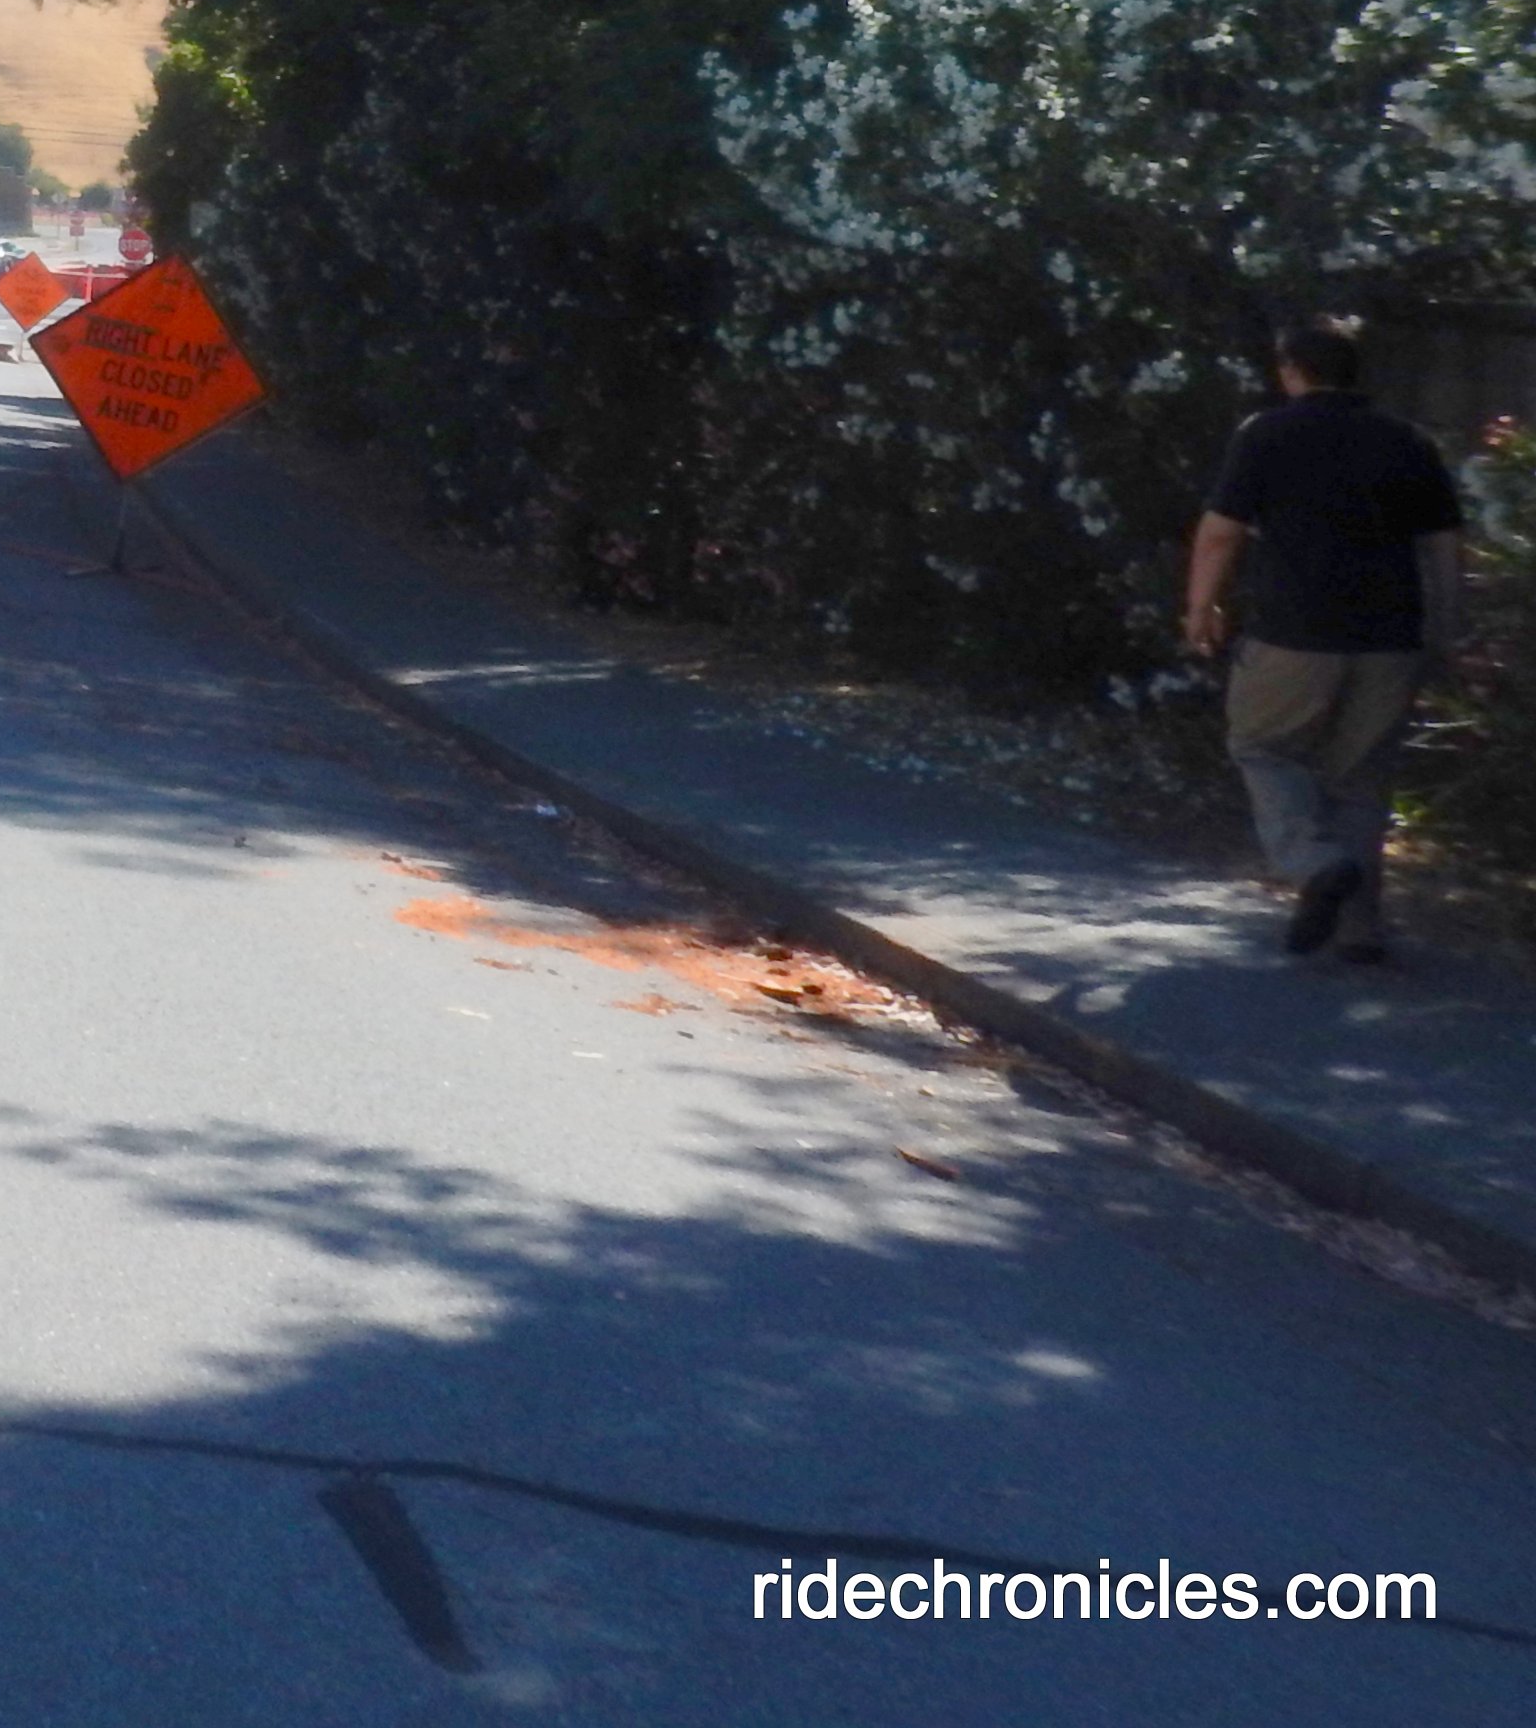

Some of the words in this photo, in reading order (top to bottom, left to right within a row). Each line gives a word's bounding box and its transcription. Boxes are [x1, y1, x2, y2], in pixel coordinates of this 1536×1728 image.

[119, 240, 150, 253] STOP
[87, 320, 157, 356] RIGHT
[159, 339, 228, 372] LANE
[100, 358, 193, 401] CLOSED
[99, 397, 179, 432] AHEAD
